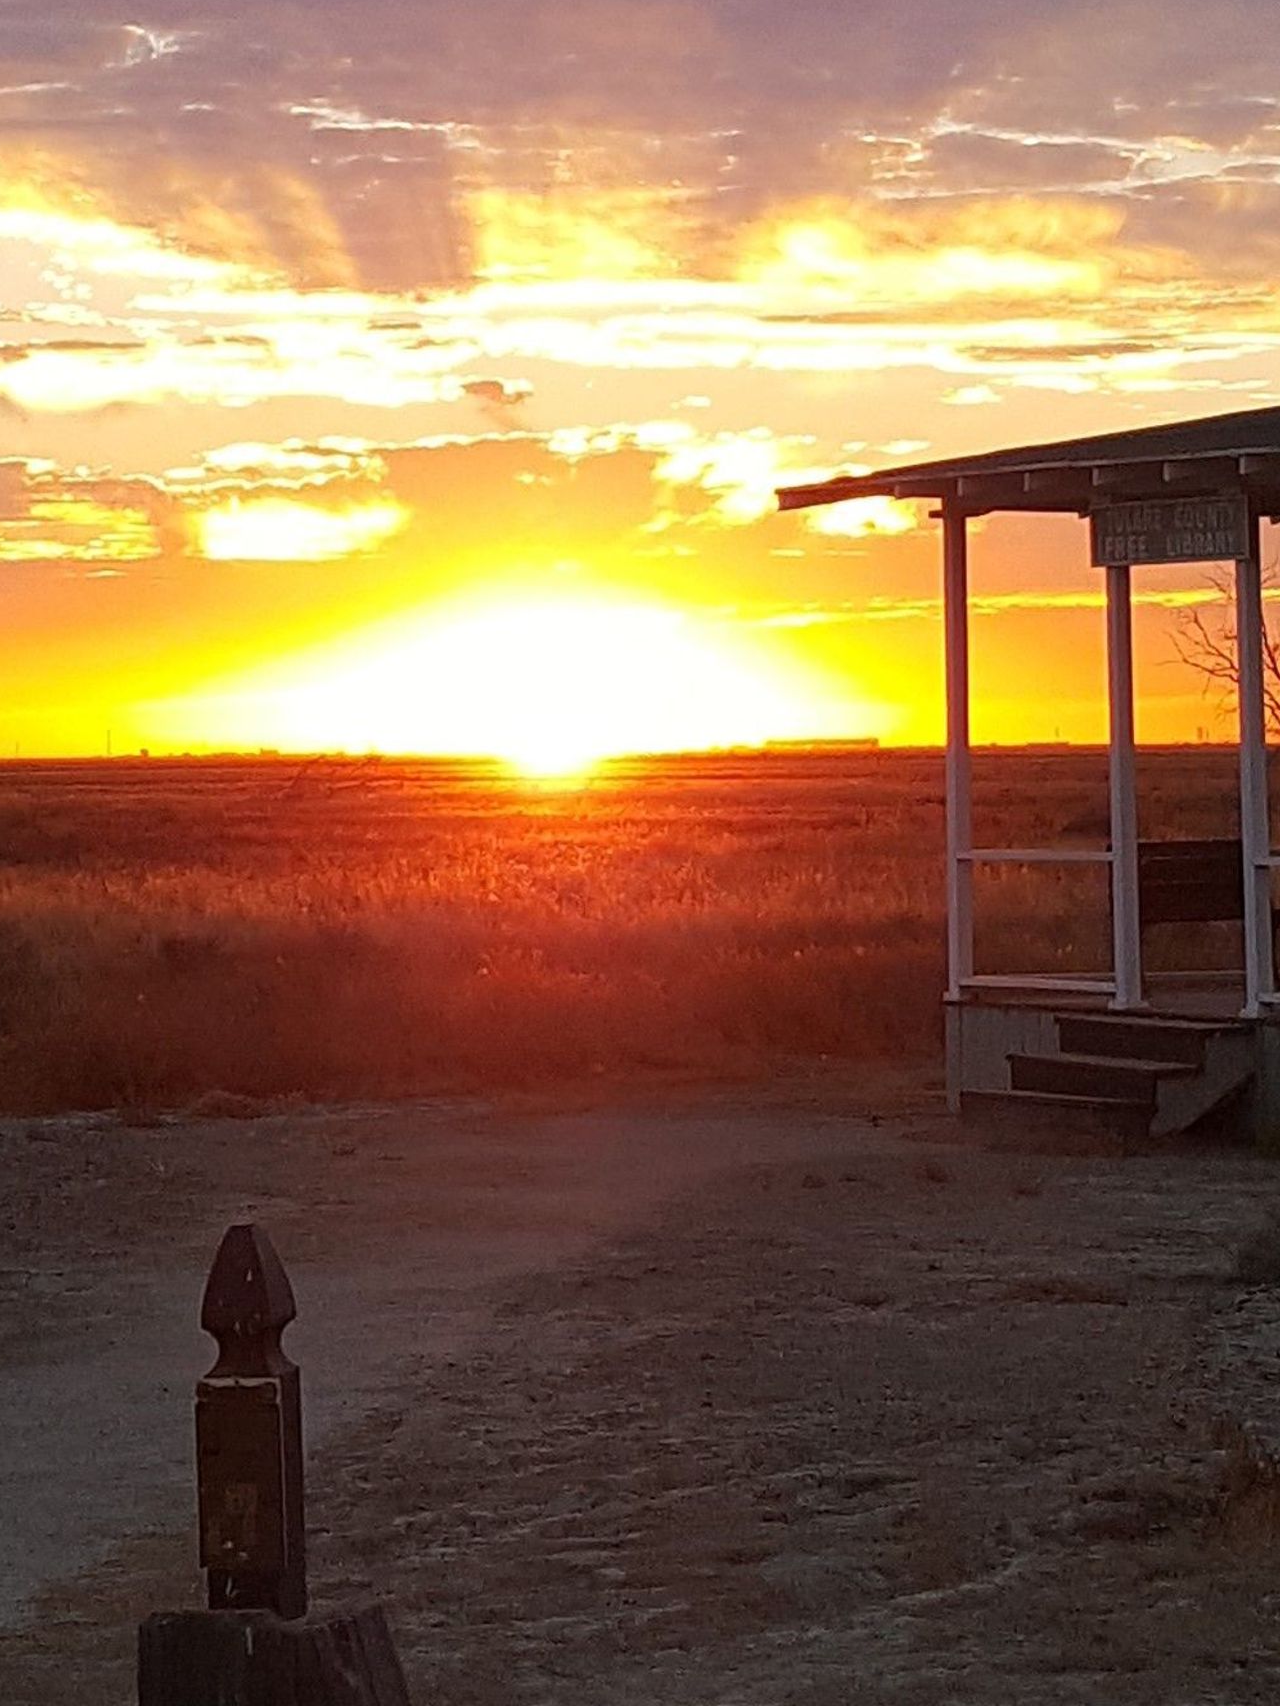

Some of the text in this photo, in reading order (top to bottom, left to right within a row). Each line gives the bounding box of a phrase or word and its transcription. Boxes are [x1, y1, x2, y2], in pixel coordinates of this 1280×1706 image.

[1105, 503, 1236, 533] TULARE COUNTY
[1104, 530, 1237, 559] FREE LIBRARY
